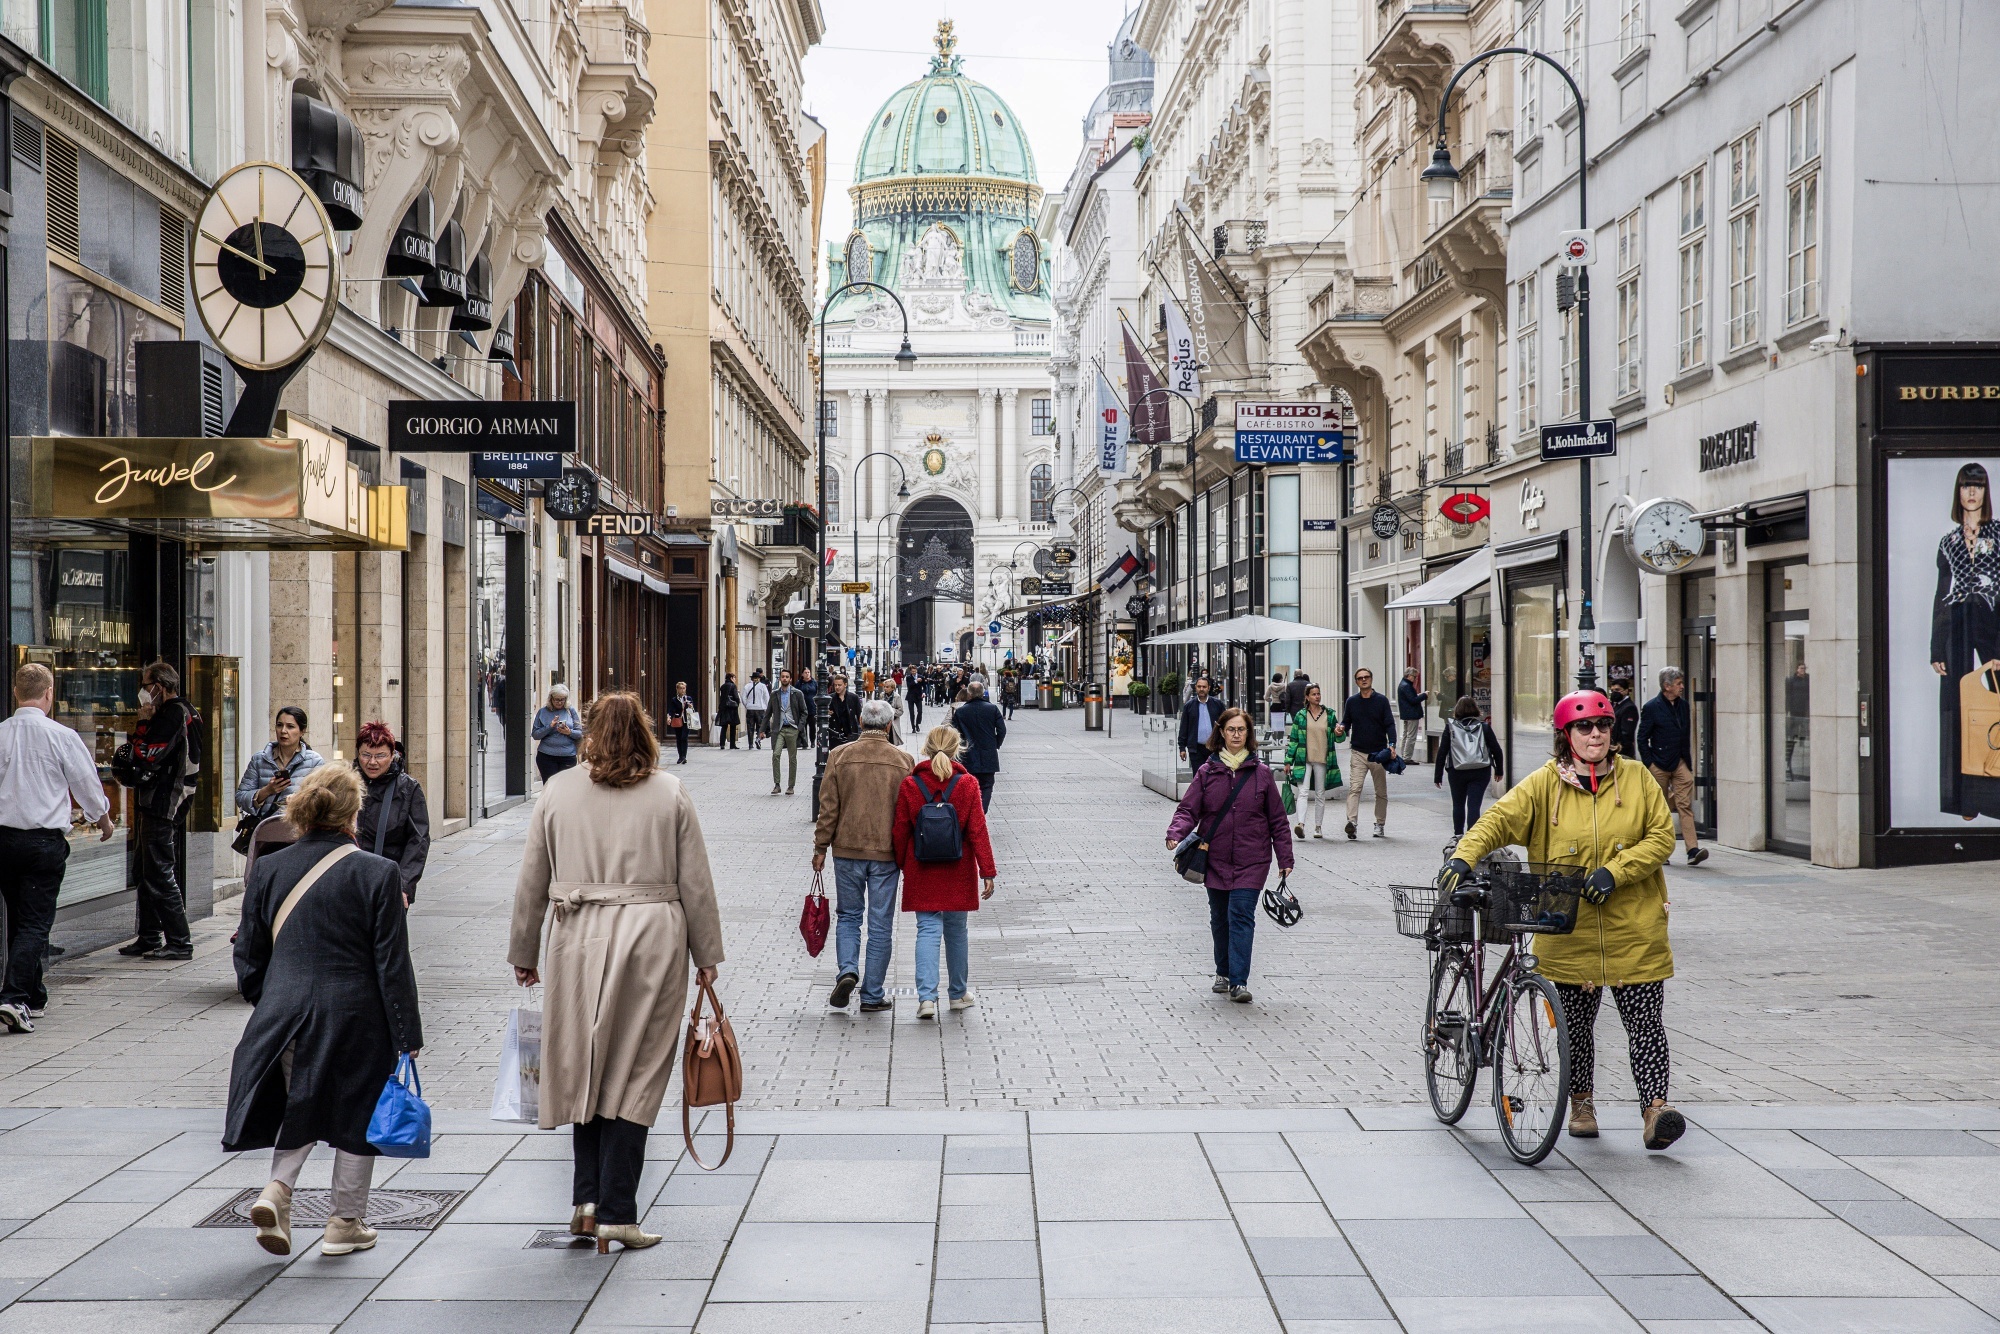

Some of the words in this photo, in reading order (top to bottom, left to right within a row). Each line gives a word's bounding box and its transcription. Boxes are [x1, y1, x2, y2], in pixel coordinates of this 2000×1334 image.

[1187, 257, 1205, 324] GABBANA
[1195, 331, 1212, 374] DOLCE
[1177, 338, 1197, 392] Regus
[1899, 386, 2000, 400] BURBE
[1240, 407, 1254, 416] IL
[1257, 406, 1319, 416] TEMPO
[406, 417, 483, 435] GIORGIO
[488, 418, 559, 435] ARMANI
[1102, 425, 1118, 470] ERSTE
[1240, 434, 1315, 444] RESTAURANT
[1699, 421, 1757, 473] BREGUET
[483, 452, 554, 461] BREITLING
[1240, 445, 1316, 459] LEVANTE
[95, 451, 237, 504] Juwel
[714, 501, 781, 514] GUCCI
[588, 515, 651, 534] FENDI
